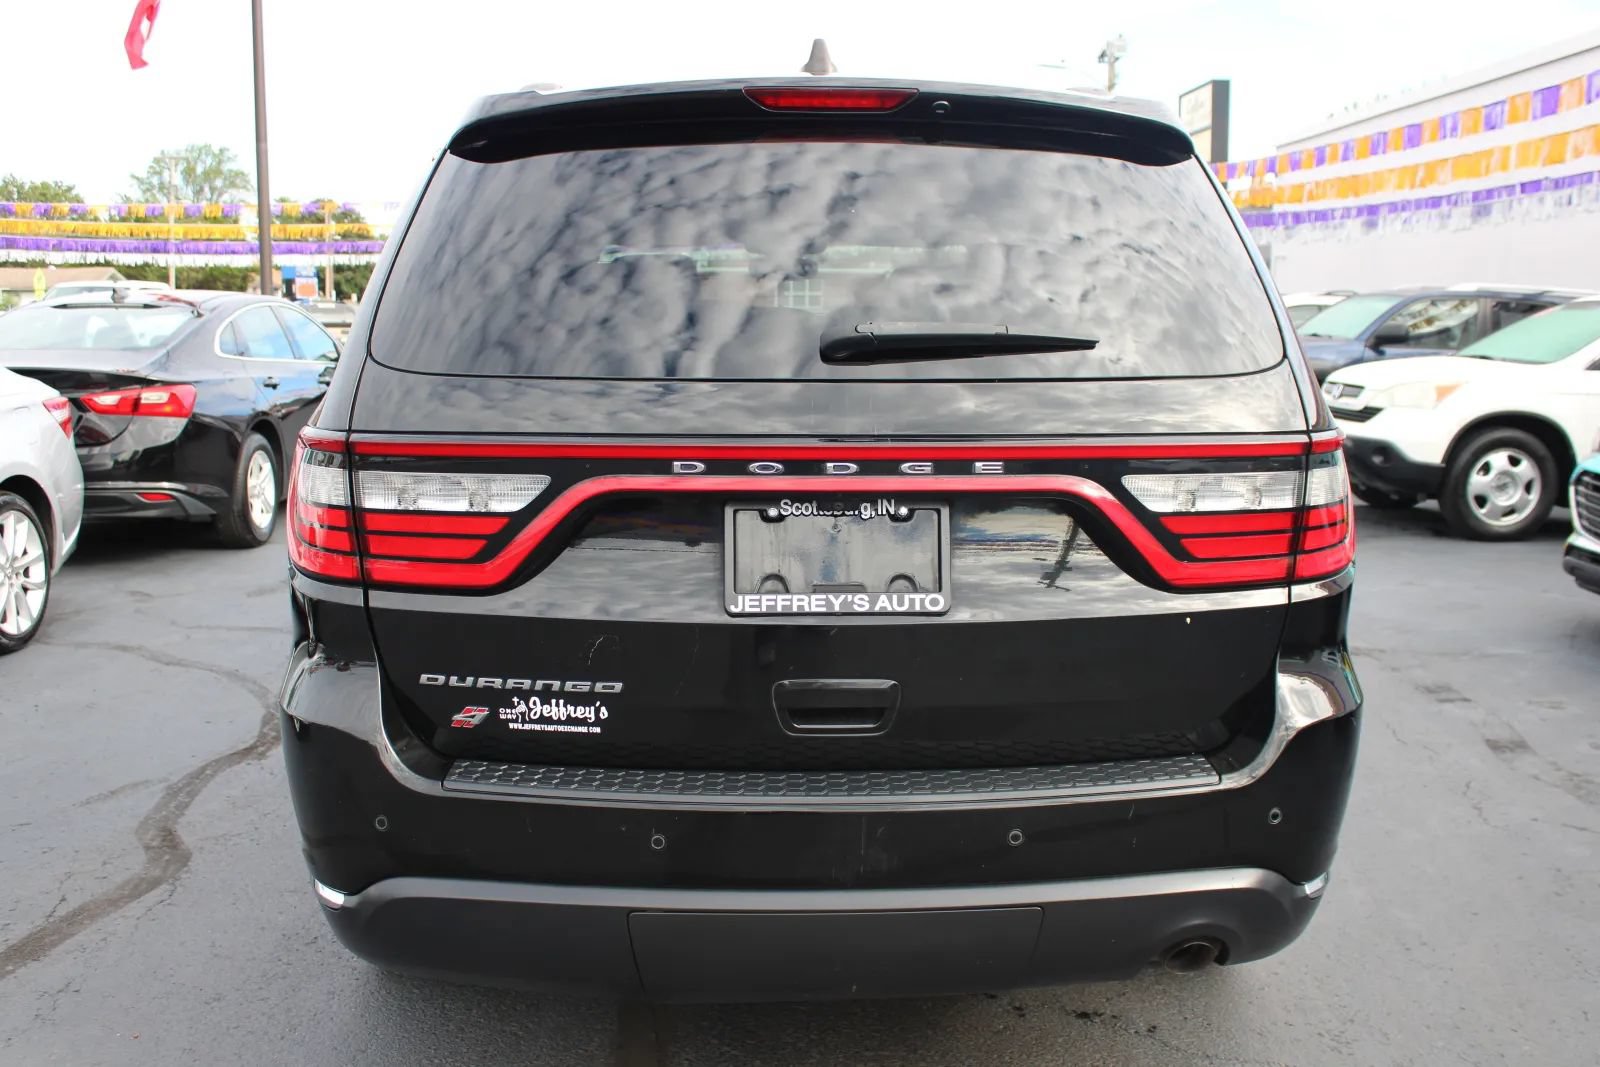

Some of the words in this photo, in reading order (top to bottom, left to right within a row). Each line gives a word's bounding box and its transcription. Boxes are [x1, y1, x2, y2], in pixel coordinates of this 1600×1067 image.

[672, 461, 1004, 475] DODGE
[729, 593, 870, 613] JEFFREY'S
[874, 593, 945, 611] AUTO
[418, 673, 624, 693] DURANGO
[528, 696, 609, 723] Jeffrey's
